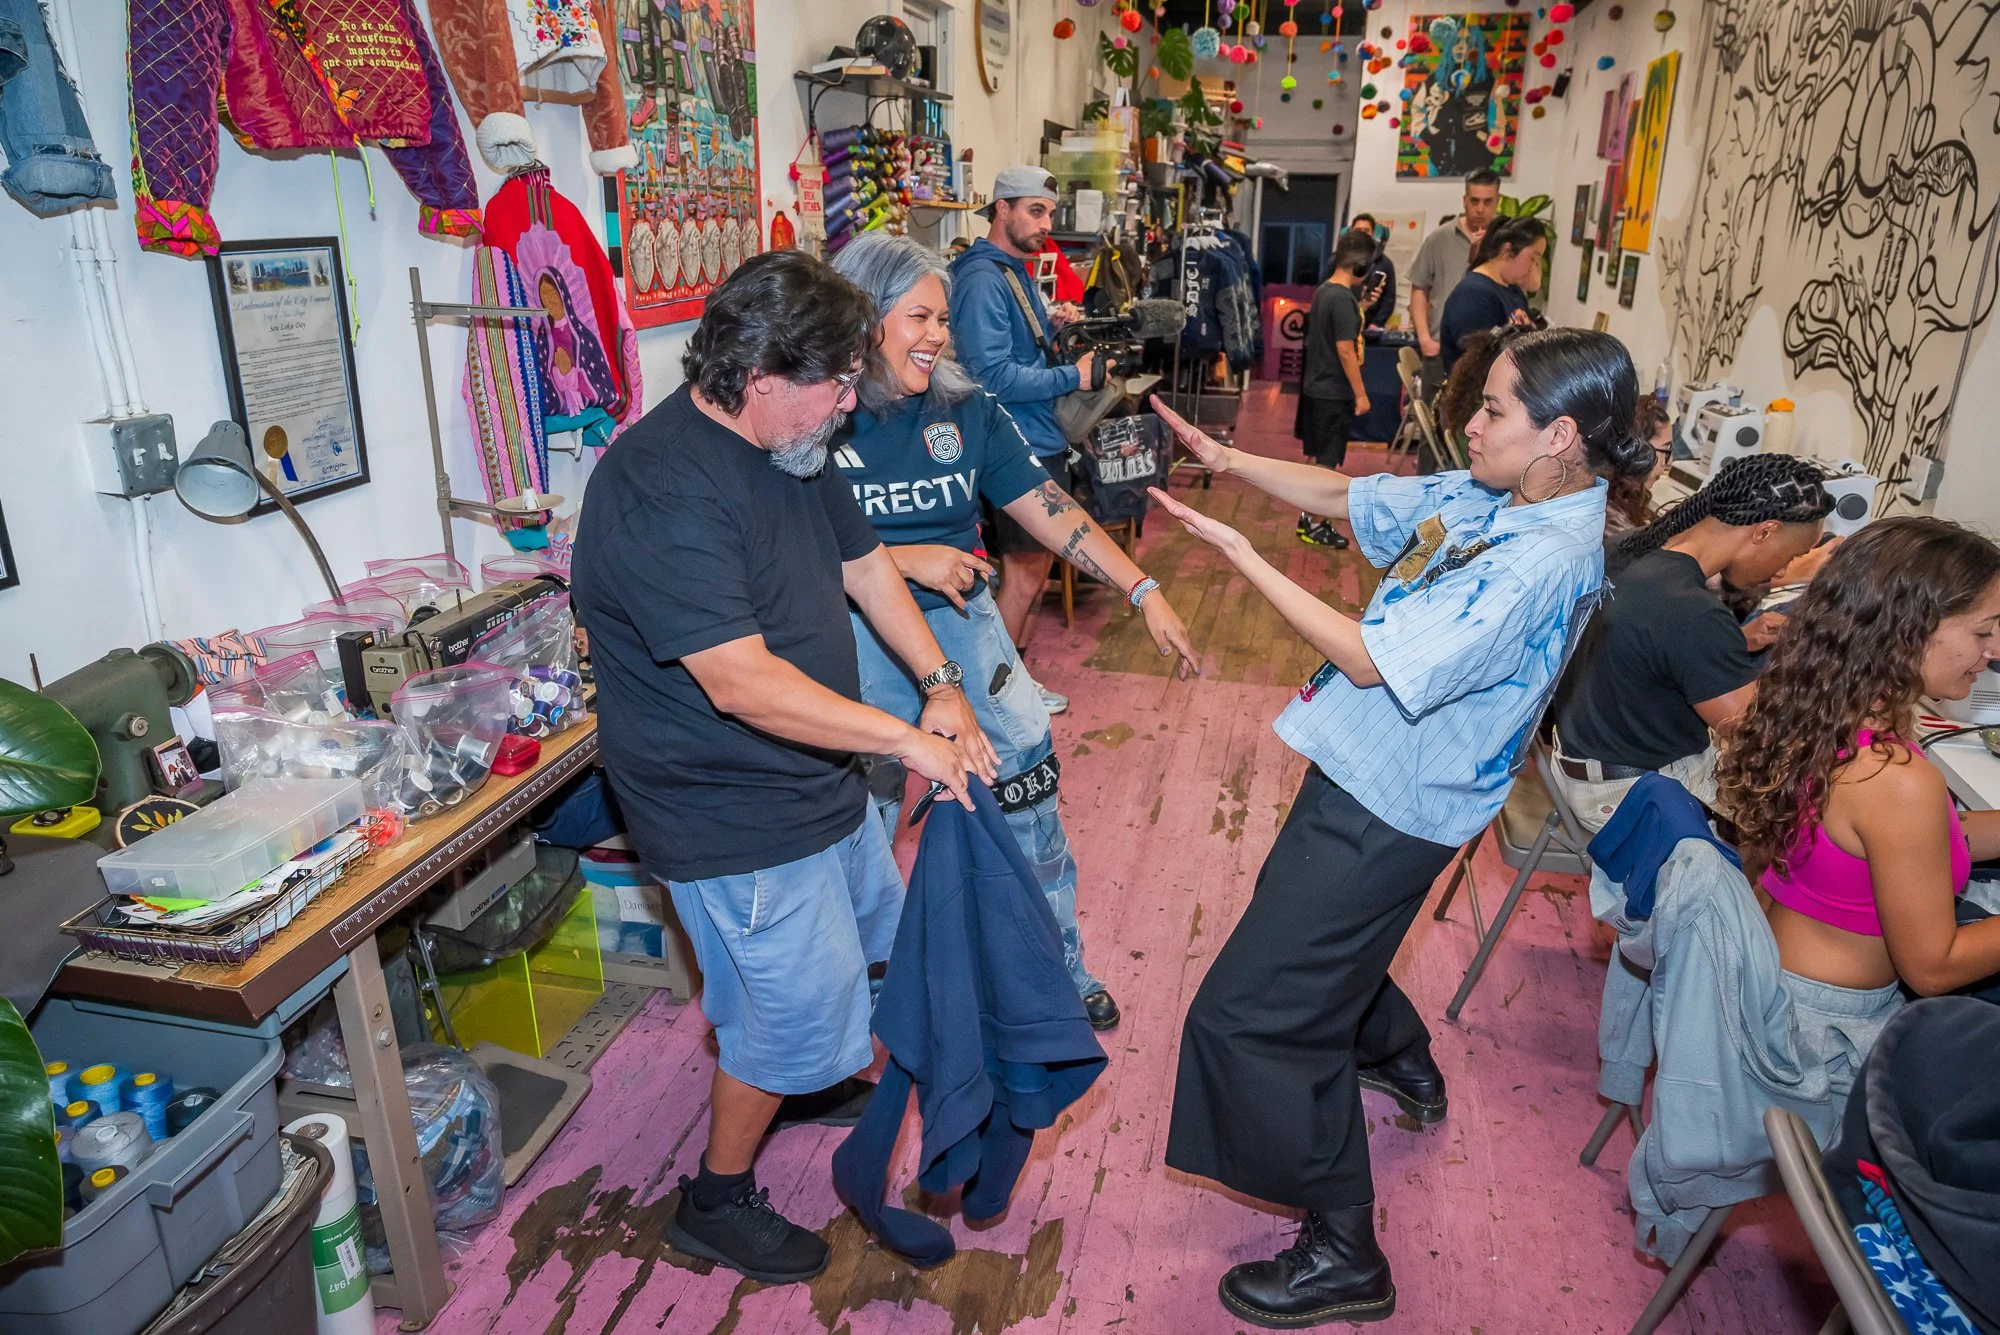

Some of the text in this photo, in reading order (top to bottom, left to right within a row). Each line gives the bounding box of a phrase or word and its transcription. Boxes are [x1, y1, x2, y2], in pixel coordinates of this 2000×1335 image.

[340, 20, 357, 32] No
[361, 20, 373, 31] se
[326, 33, 340, 45] Se
[345, 32, 402, 45] transforma
[348, 47, 402, 57] manera en
[322, 58, 340, 70] que
[345, 58, 365, 67] nos
[927, 424, 956, 439] SAN DIEGO
[448, 637, 469, 653] brother
[371, 666, 395, 674] brother
[992, 763, 1058, 807] OKA
[470, 896, 491, 918] brother
[322, 1232, 343, 1244] Service
[328, 1278, 352, 1293] 1947
